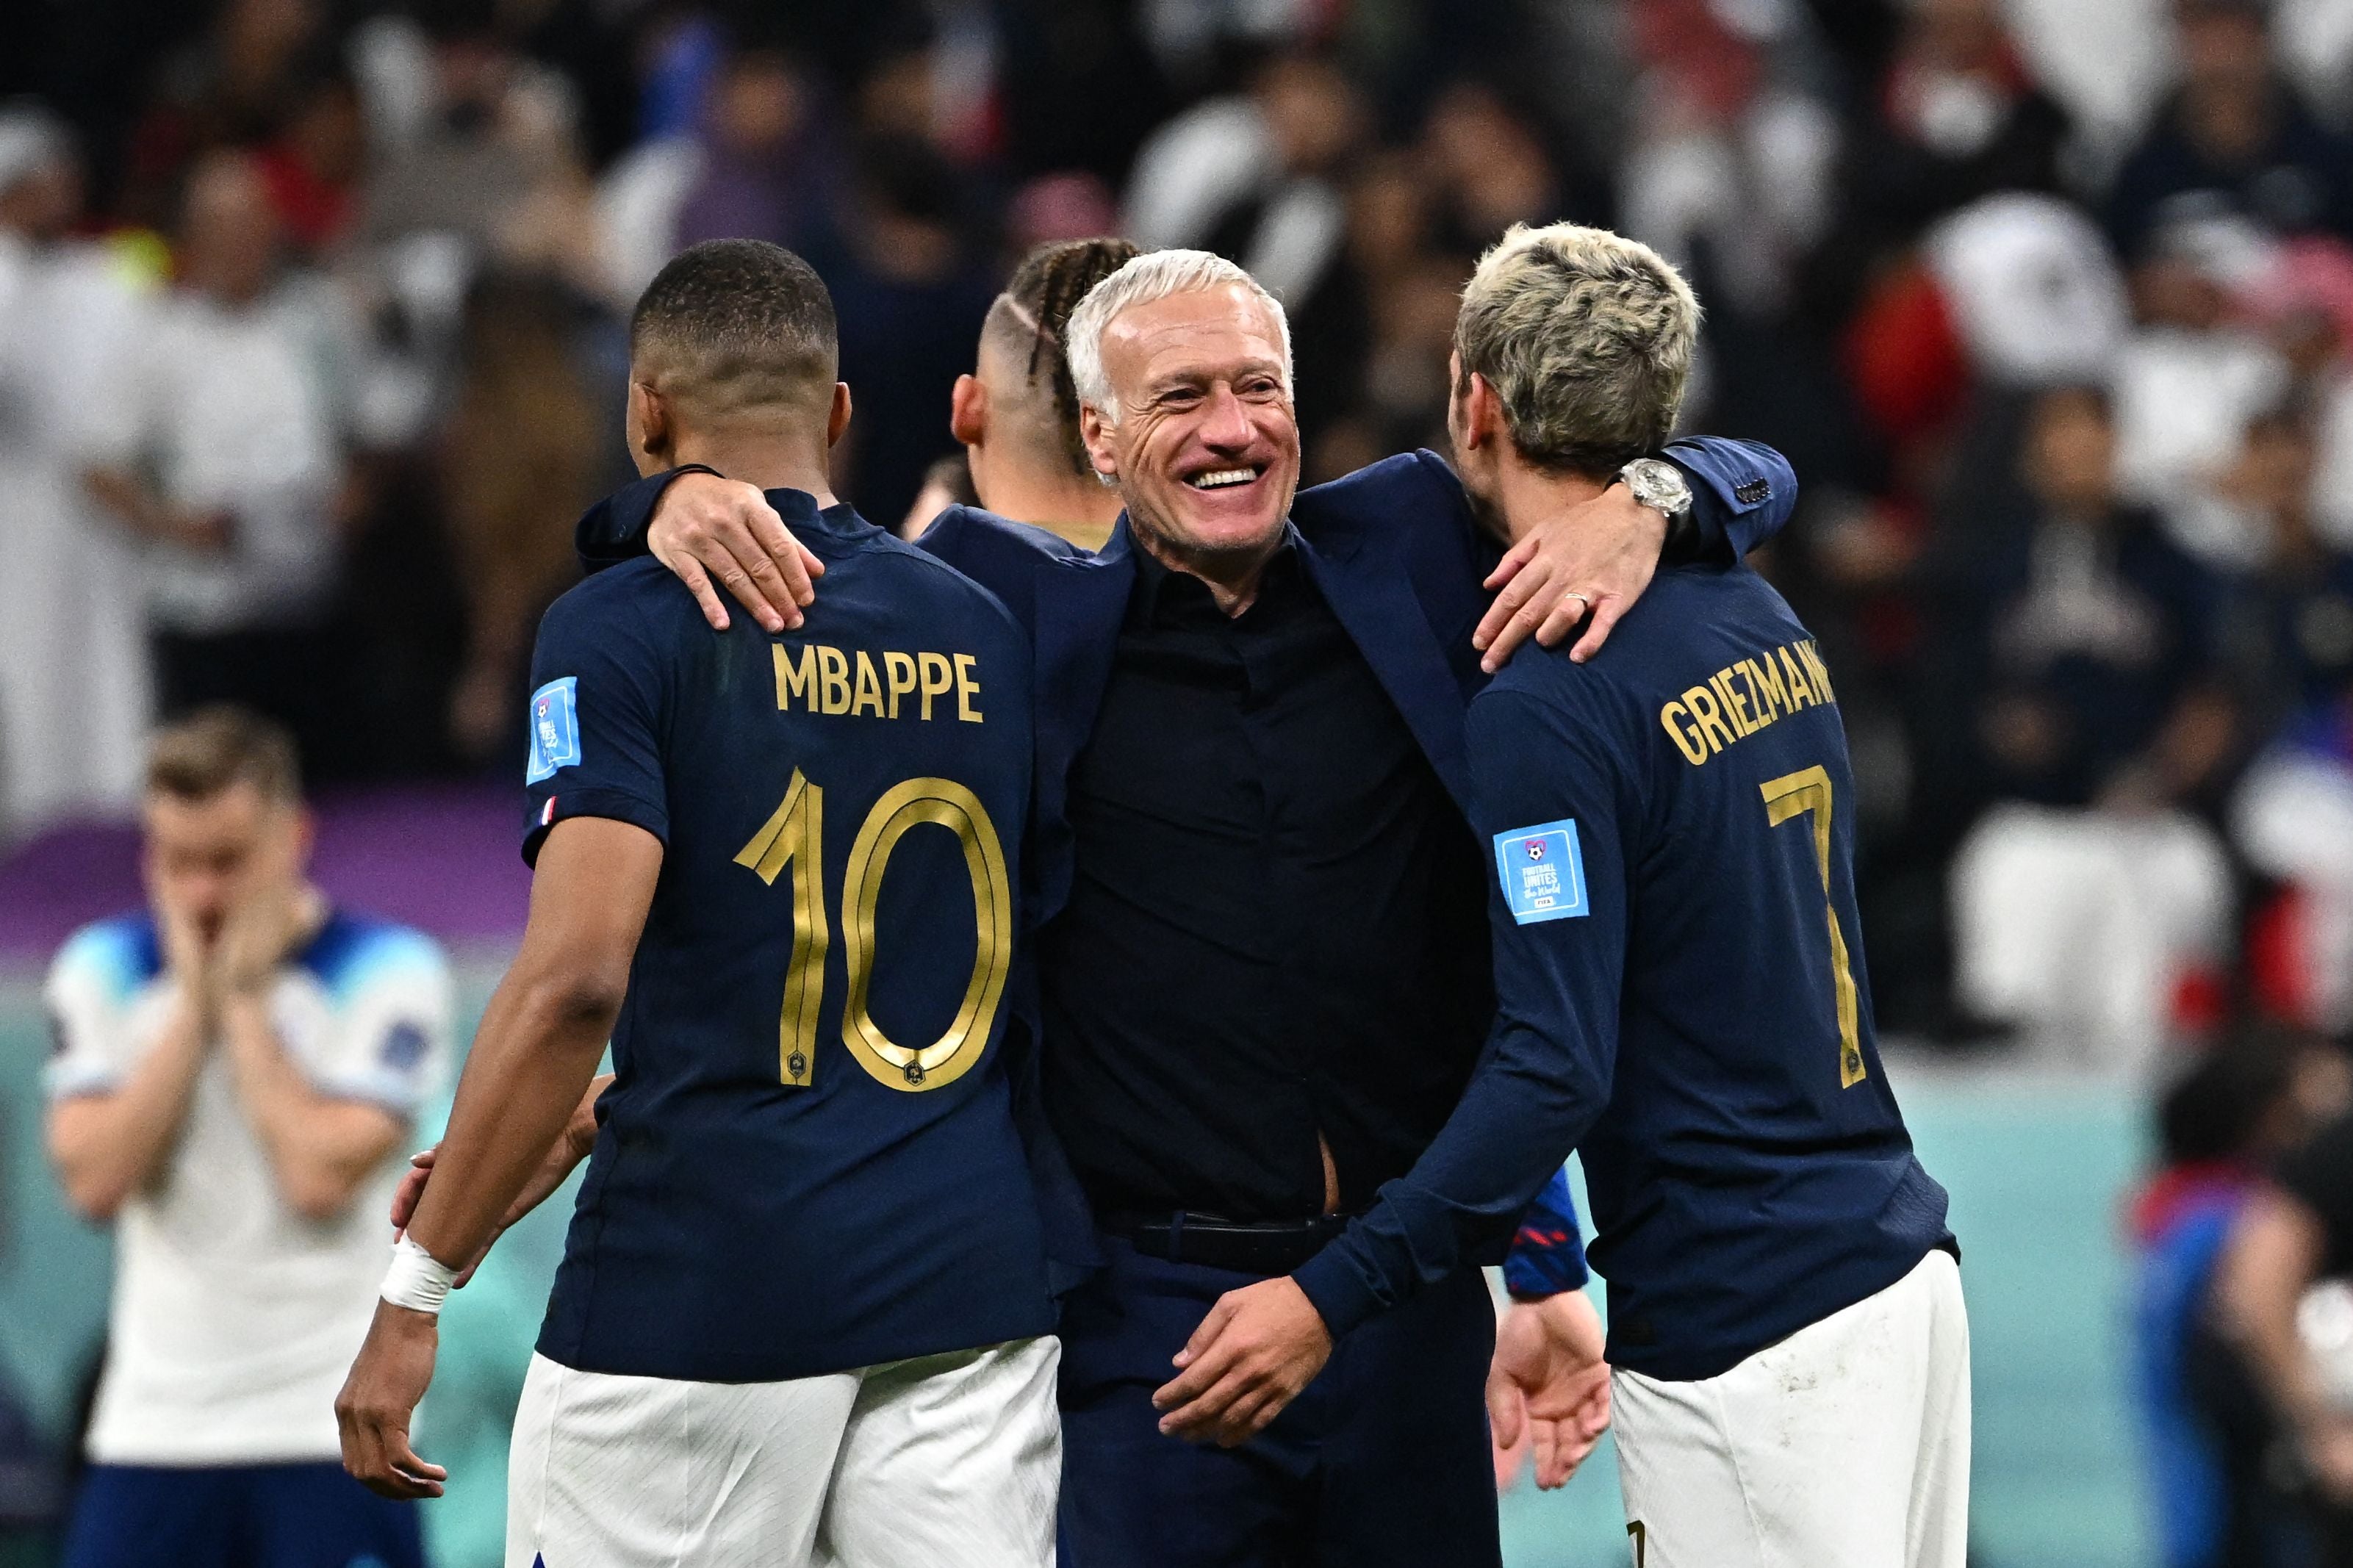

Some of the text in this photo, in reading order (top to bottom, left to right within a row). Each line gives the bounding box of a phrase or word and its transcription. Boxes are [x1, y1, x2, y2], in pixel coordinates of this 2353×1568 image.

[772, 643, 983, 723] MBAPPE
[733, 766, 1012, 1093] 10
[1523, 871, 1558, 888] UNITES
[1759, 764, 1867, 1090] 7
